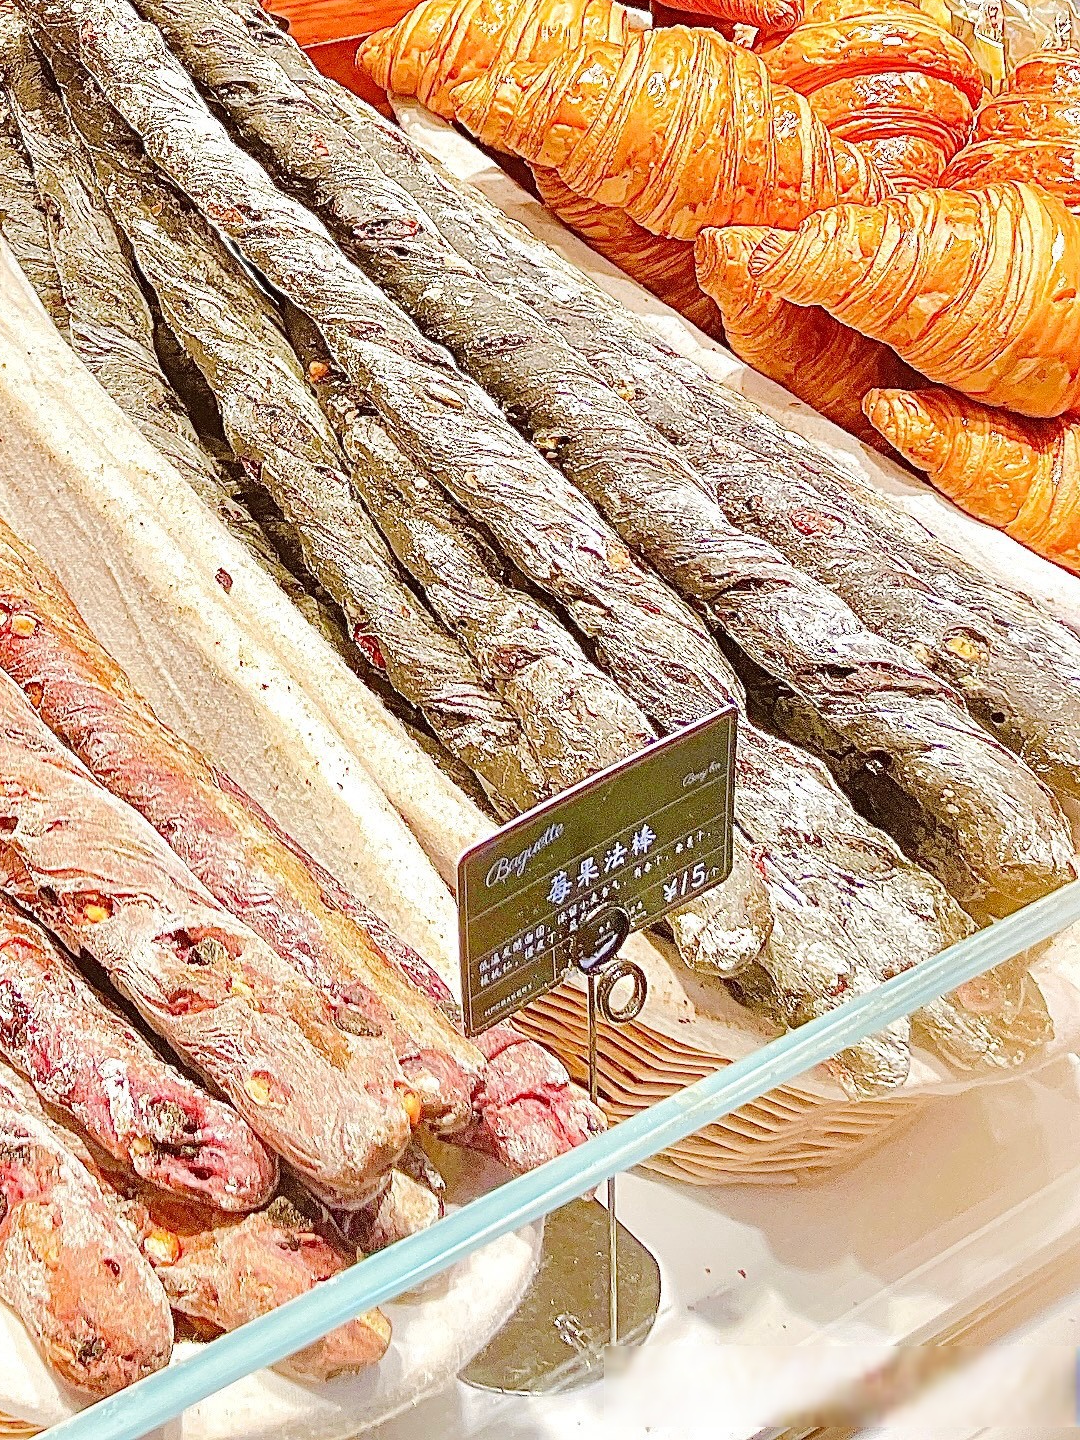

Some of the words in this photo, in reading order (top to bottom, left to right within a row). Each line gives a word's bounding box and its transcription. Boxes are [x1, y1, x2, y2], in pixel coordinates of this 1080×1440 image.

[485, 823, 564, 888] Baguette
[547, 823, 657, 905] 莓果法棒
